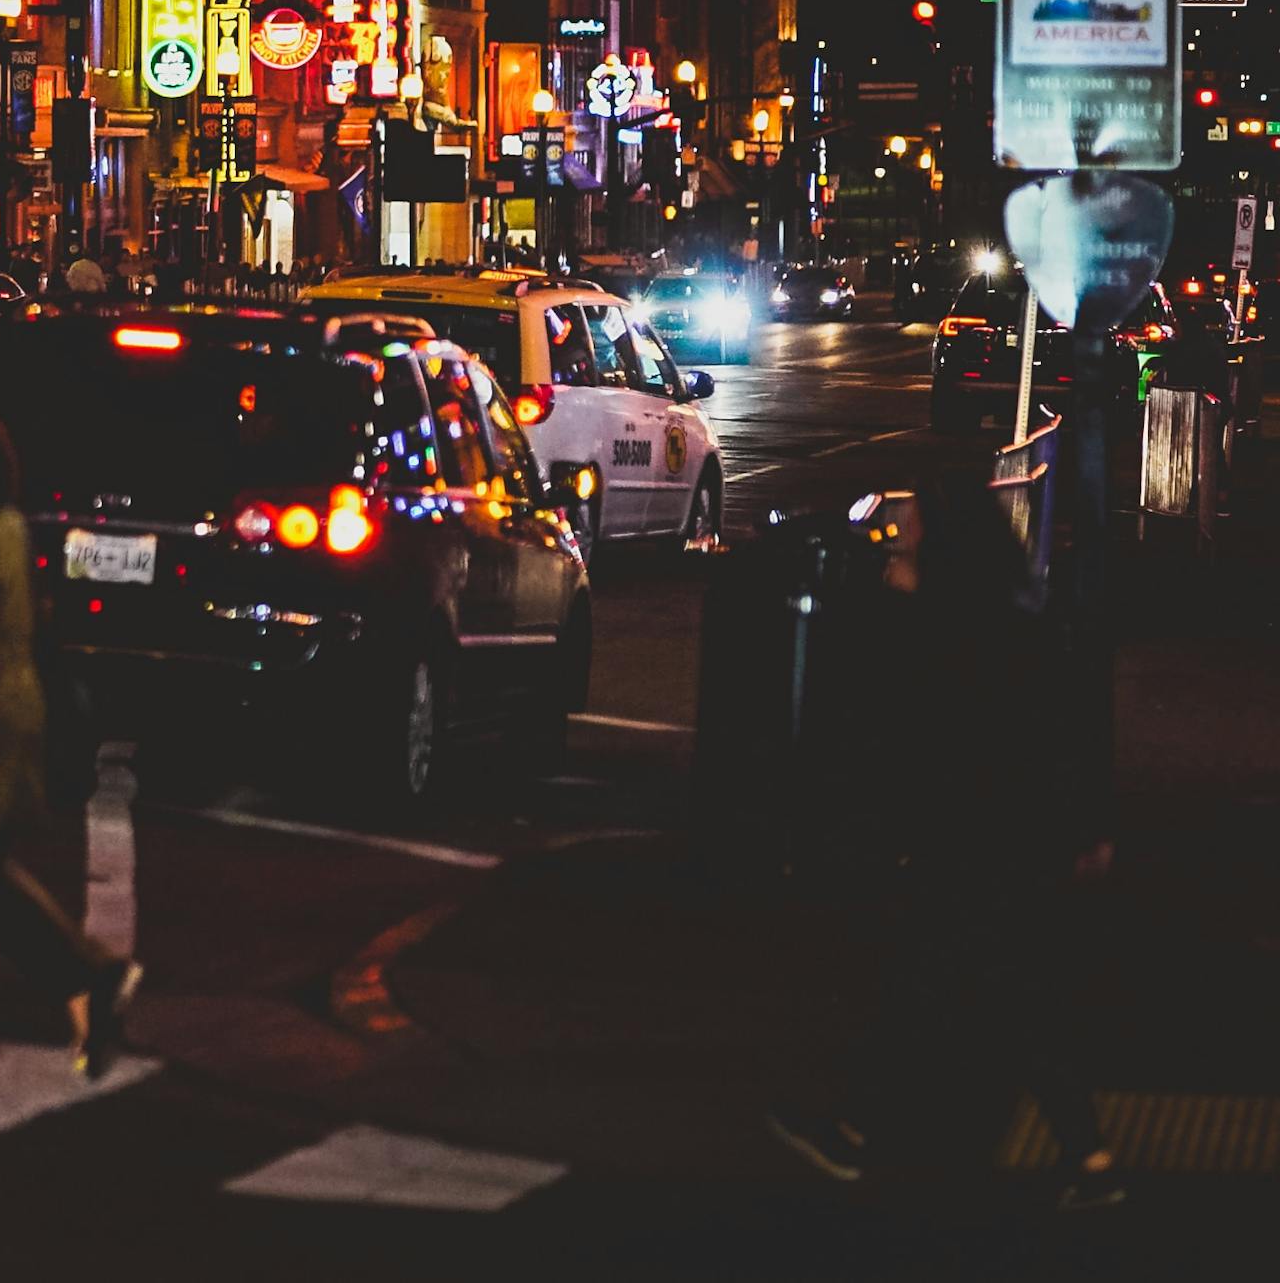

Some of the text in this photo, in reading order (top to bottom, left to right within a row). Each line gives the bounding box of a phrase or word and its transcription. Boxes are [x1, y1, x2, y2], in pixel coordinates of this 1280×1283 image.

[1034, 26, 1151, 41] AMERICA
[251, 33, 278, 65] CANDY
[282, 32, 318, 66] KITCHEN
[1026, 77, 1152, 91] WELCOME TO
